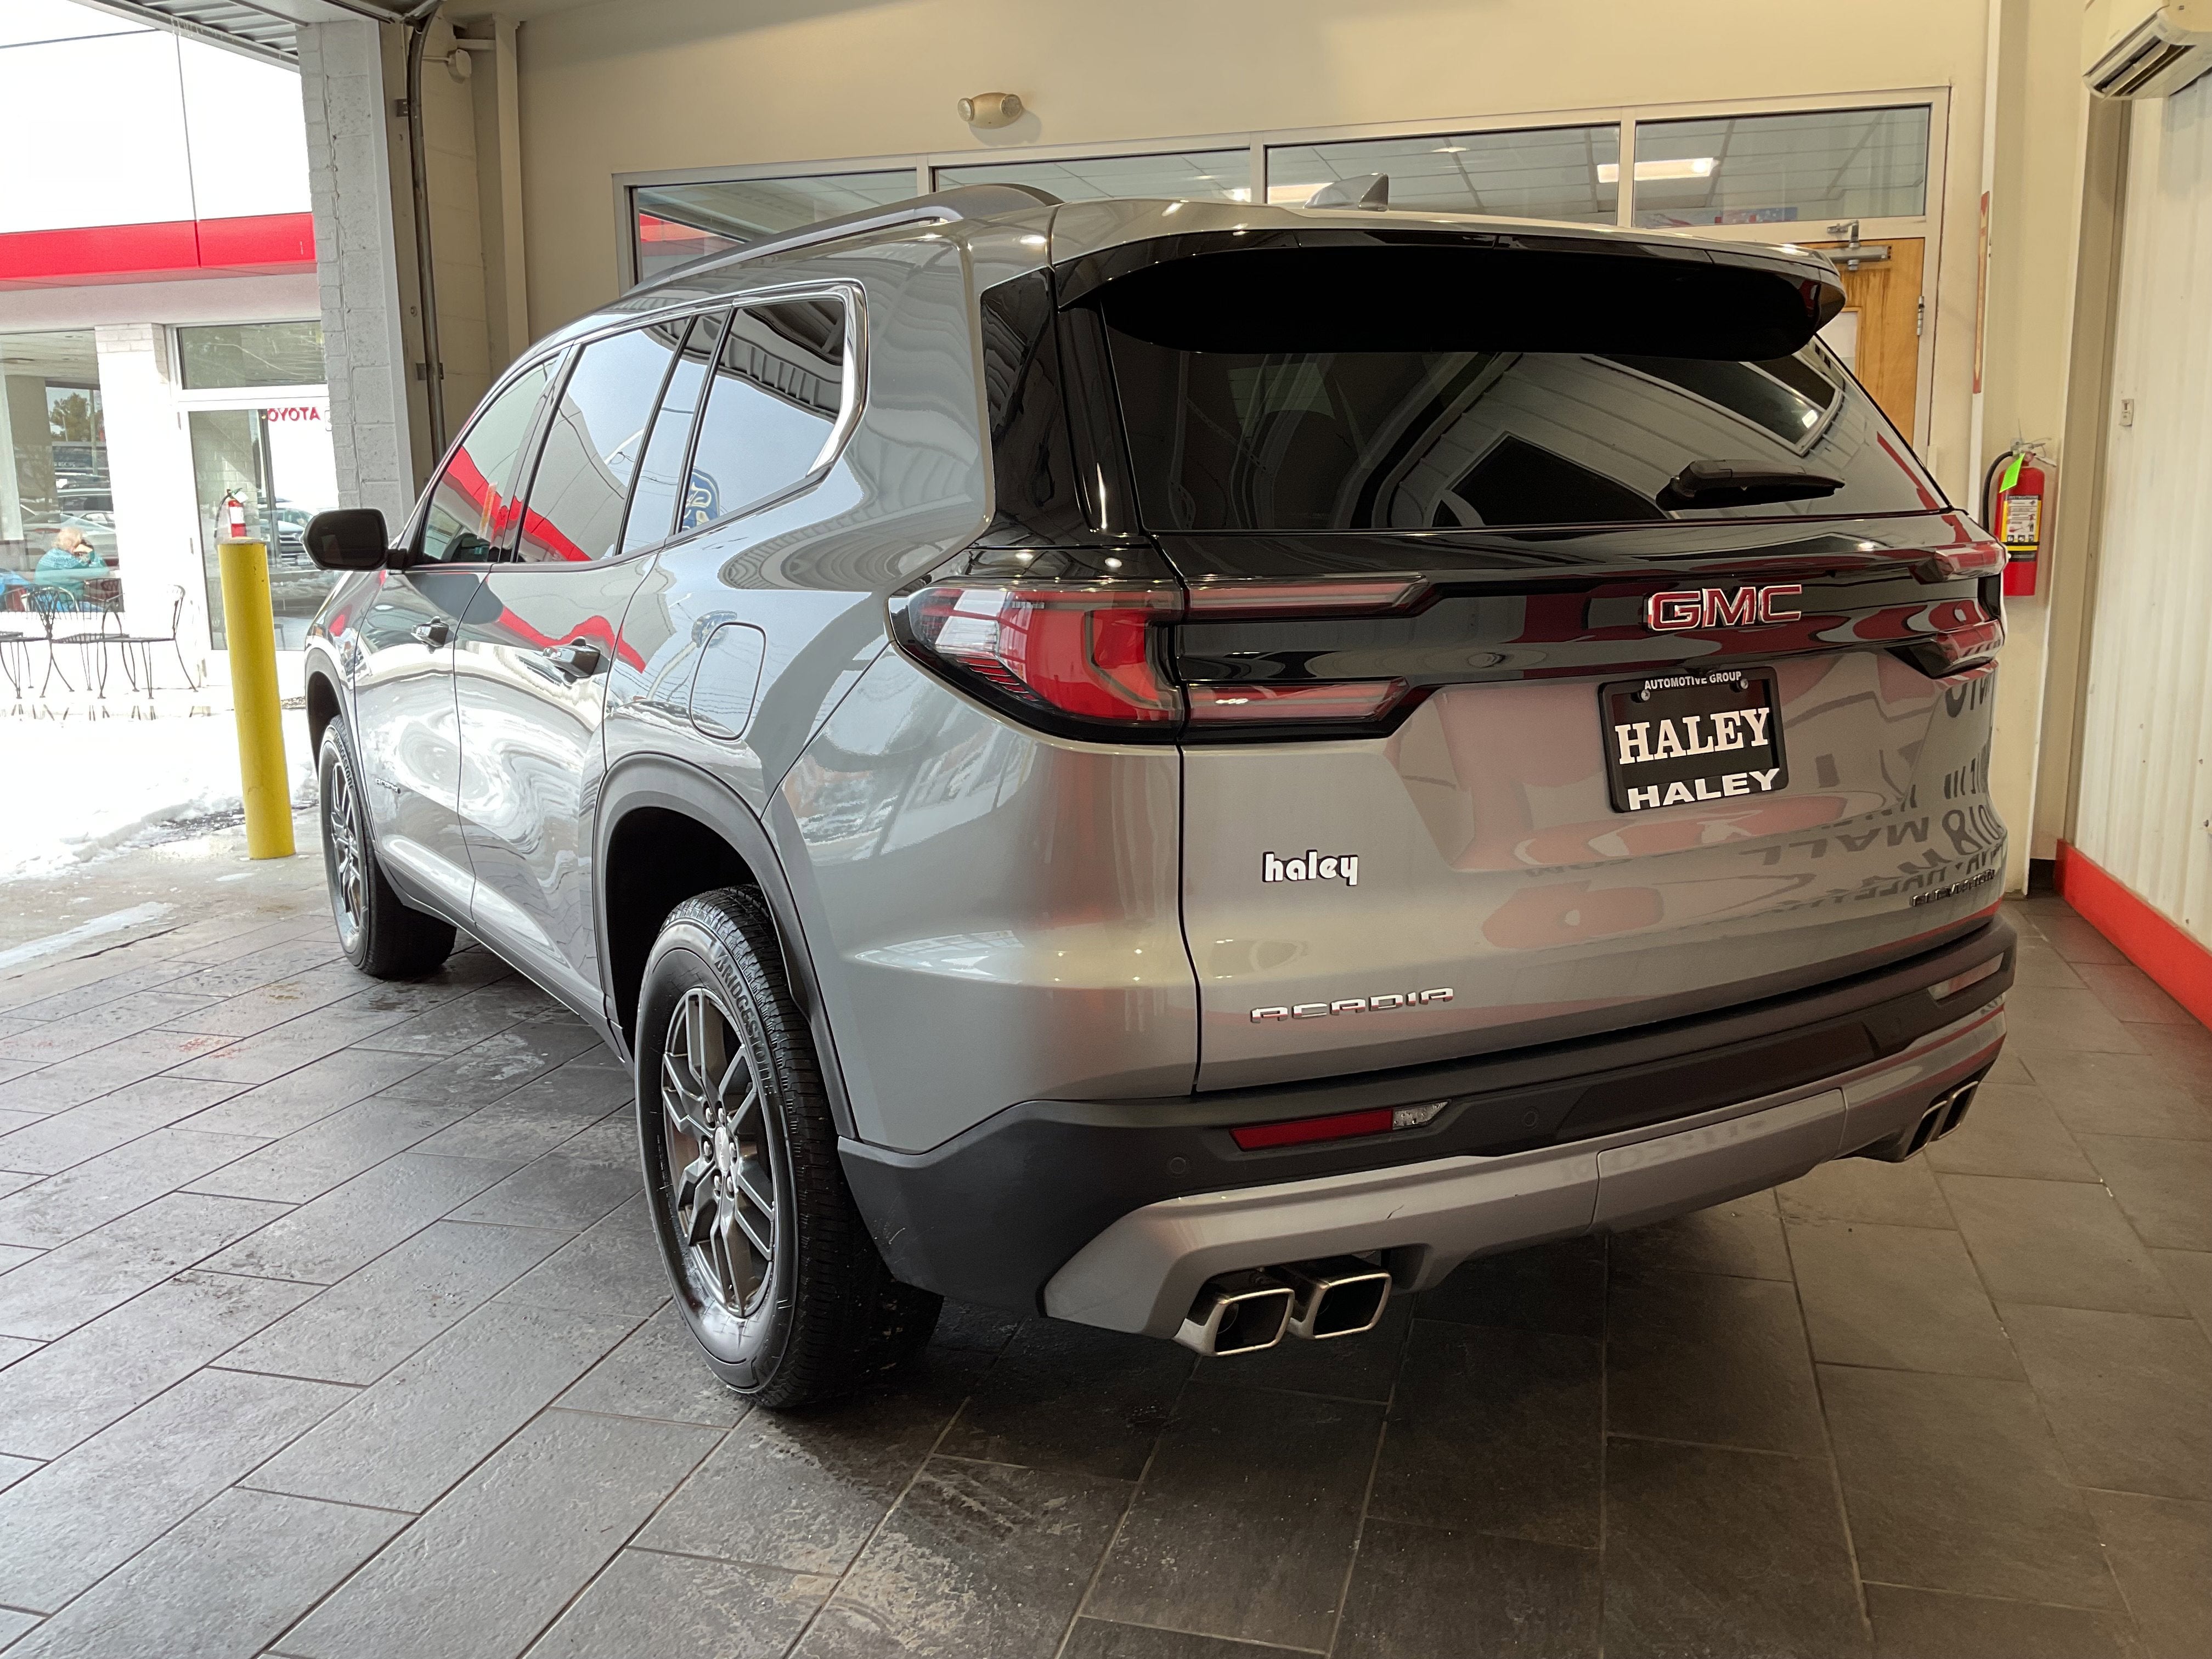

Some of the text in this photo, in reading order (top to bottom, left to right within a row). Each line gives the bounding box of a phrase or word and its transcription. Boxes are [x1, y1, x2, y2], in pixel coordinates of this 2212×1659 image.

[267, 407, 321, 422] OYOTA
[1647, 584, 1802, 631] GMC
[1644, 671, 1742, 690] AUTOMOTIVE GROUP
[1615, 707, 1770, 765] HALEY
[1627, 768, 1780, 811] HALEY
[1262, 849, 1359, 887] haley
[714, 952, 778, 1094] BRIDGESTONE
[1250, 987, 1454, 1024] ACADIA
